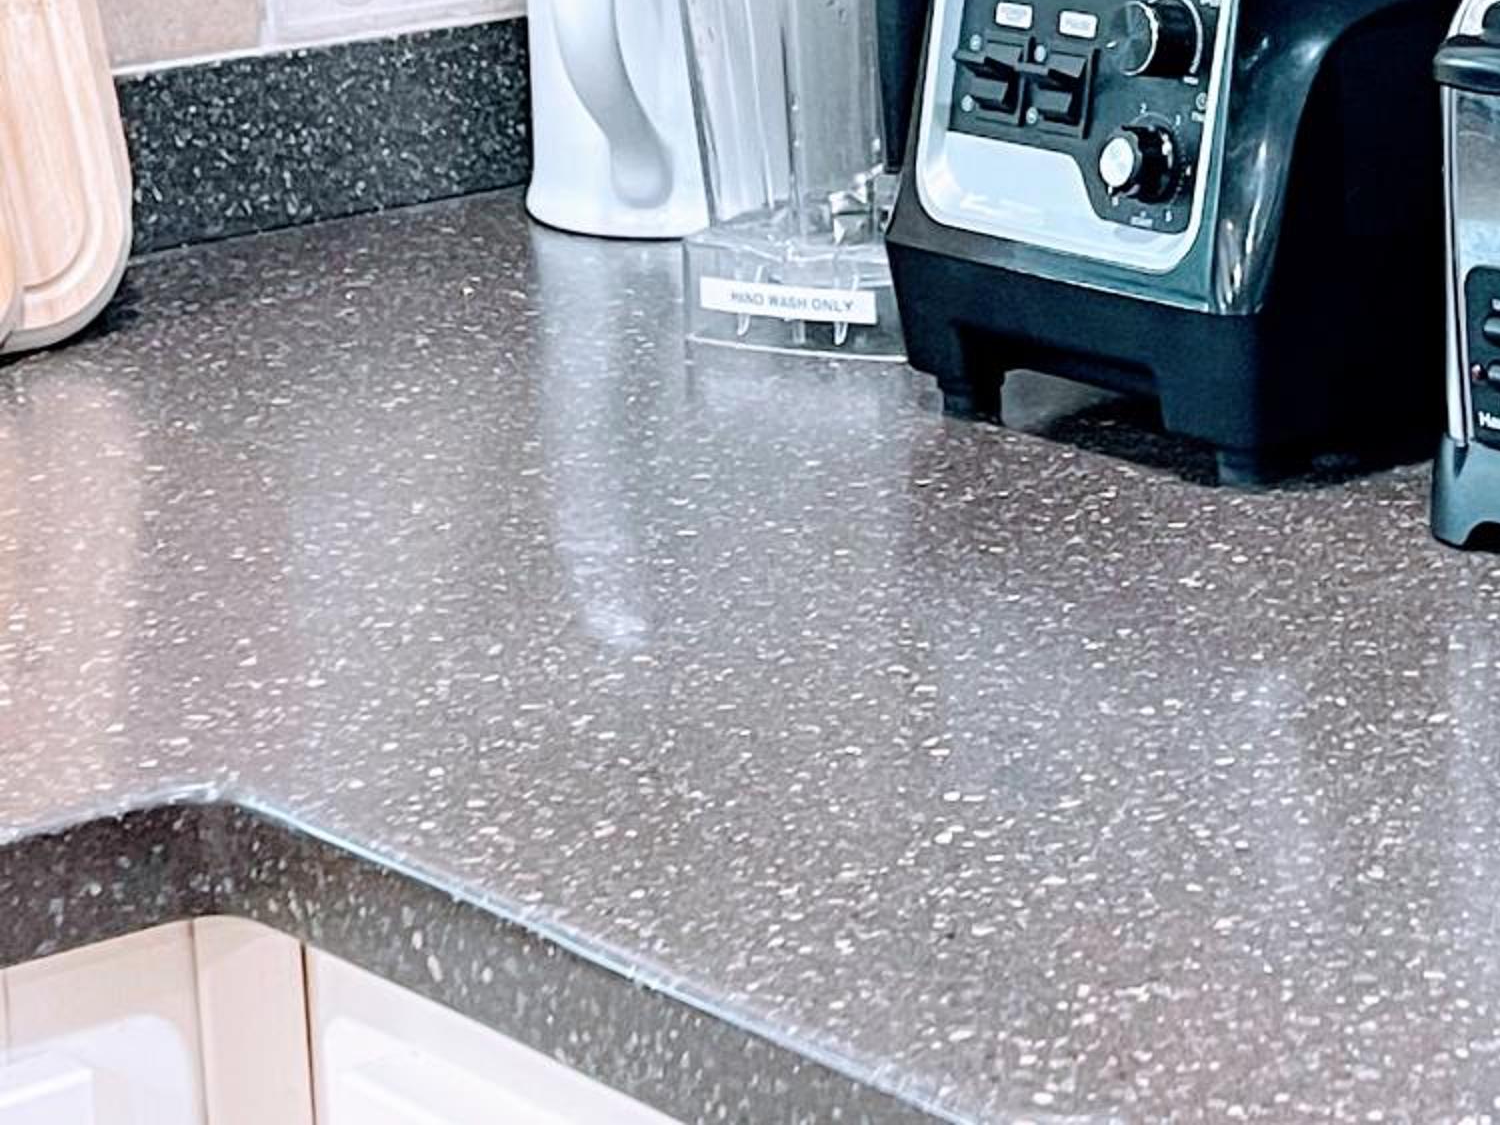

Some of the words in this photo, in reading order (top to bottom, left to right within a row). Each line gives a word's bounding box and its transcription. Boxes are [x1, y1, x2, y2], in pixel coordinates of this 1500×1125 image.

[731, 291, 765, 306] HAND
[768, 295, 807, 309] WASH
[811, 298, 855, 312] ONLY
